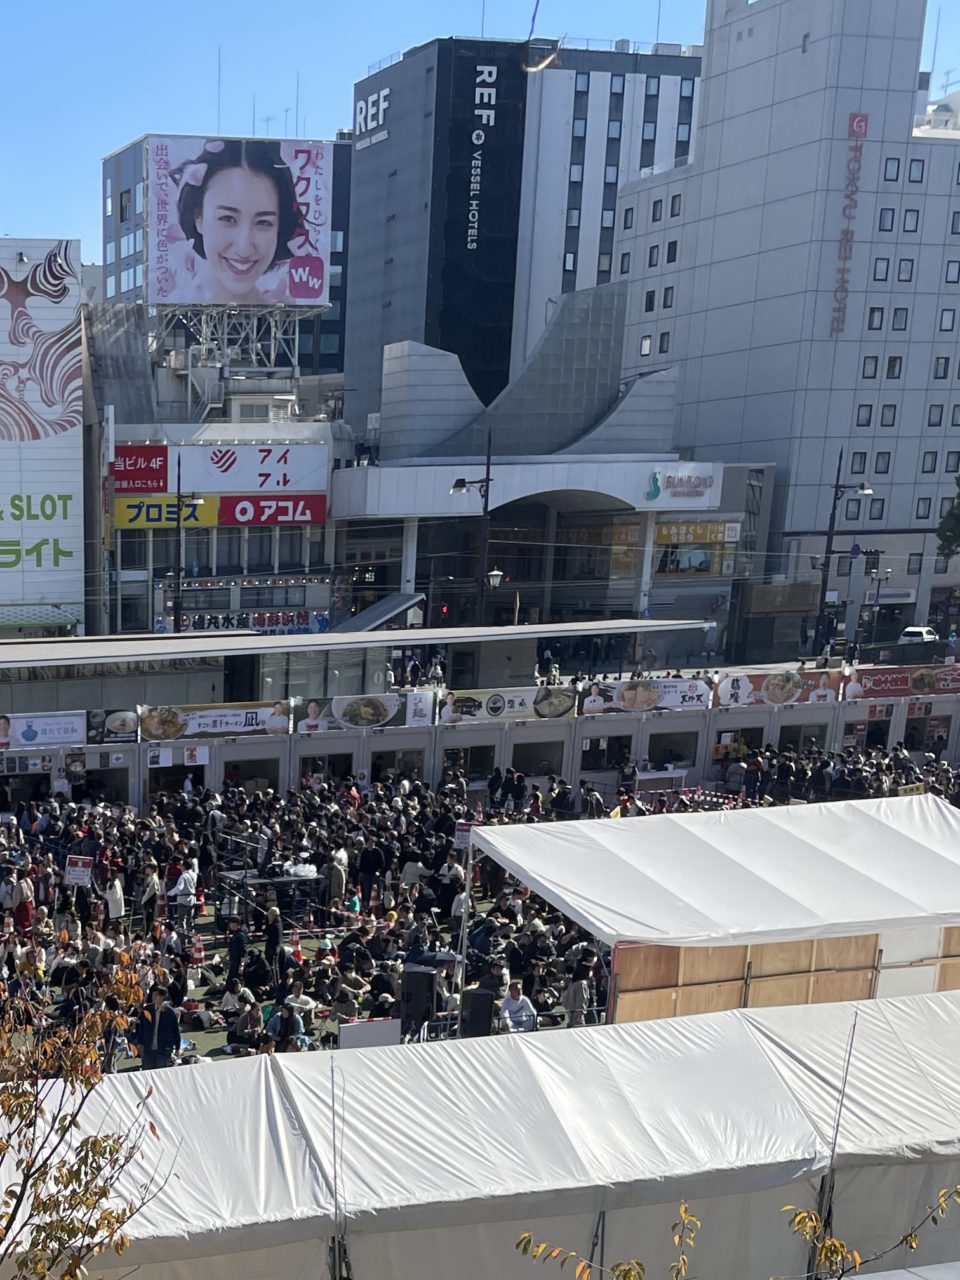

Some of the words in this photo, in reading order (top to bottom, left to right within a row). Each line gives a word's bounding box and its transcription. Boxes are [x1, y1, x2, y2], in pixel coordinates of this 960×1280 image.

[355, 87, 391, 136] REF
[474, 65, 497, 127] REF
[469, 150, 482, 197] VESSEL
[155, 143, 170, 298] 出会いで、世界に色がついた
[467, 200, 480, 250] HOTELS
[149, 457, 164, 471] 4F
[10, 494, 73, 521] SLOT
[126, 501, 200, 524] プロミス
[259, 500, 312, 522] アコム
